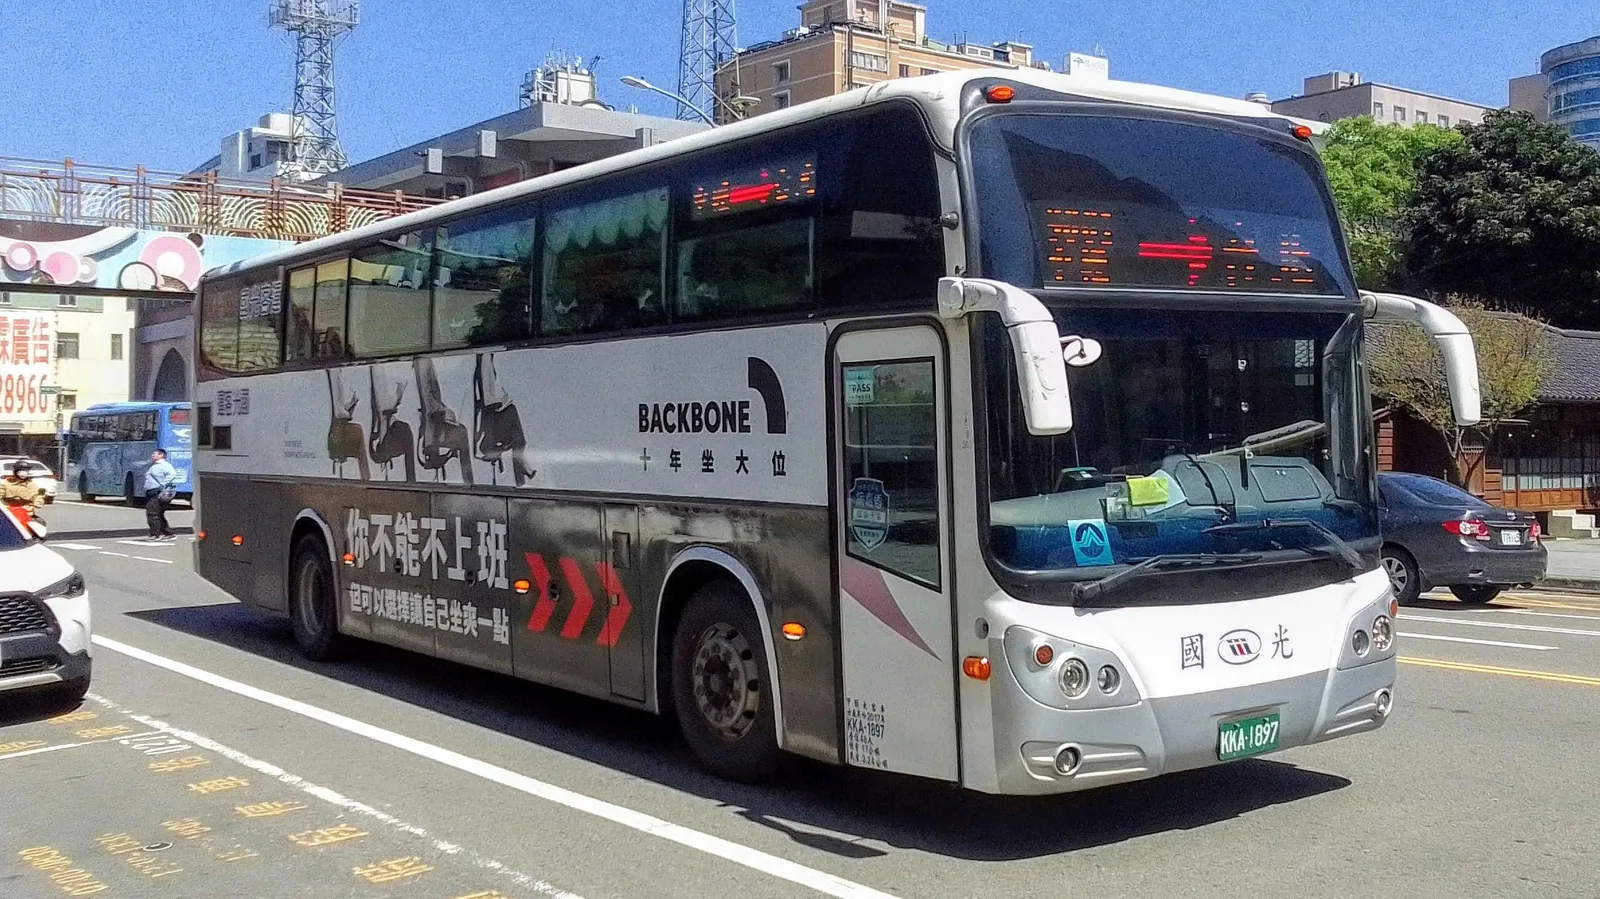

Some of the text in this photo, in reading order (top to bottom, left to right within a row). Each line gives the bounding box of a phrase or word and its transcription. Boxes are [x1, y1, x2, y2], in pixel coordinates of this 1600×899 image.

[0, 374, 48, 413] 8966
[638, 400, 751, 434] BACKBONE
[639, 447, 787, 477] 十年坐大位
[346, 507, 509, 590] 你不能不上班
[349, 581, 510, 646] 但可以選擇讓自己坐爽一點
[847, 717, 885, 739] KKA-1897
[1220, 720, 1279, 755] KKA-1897
